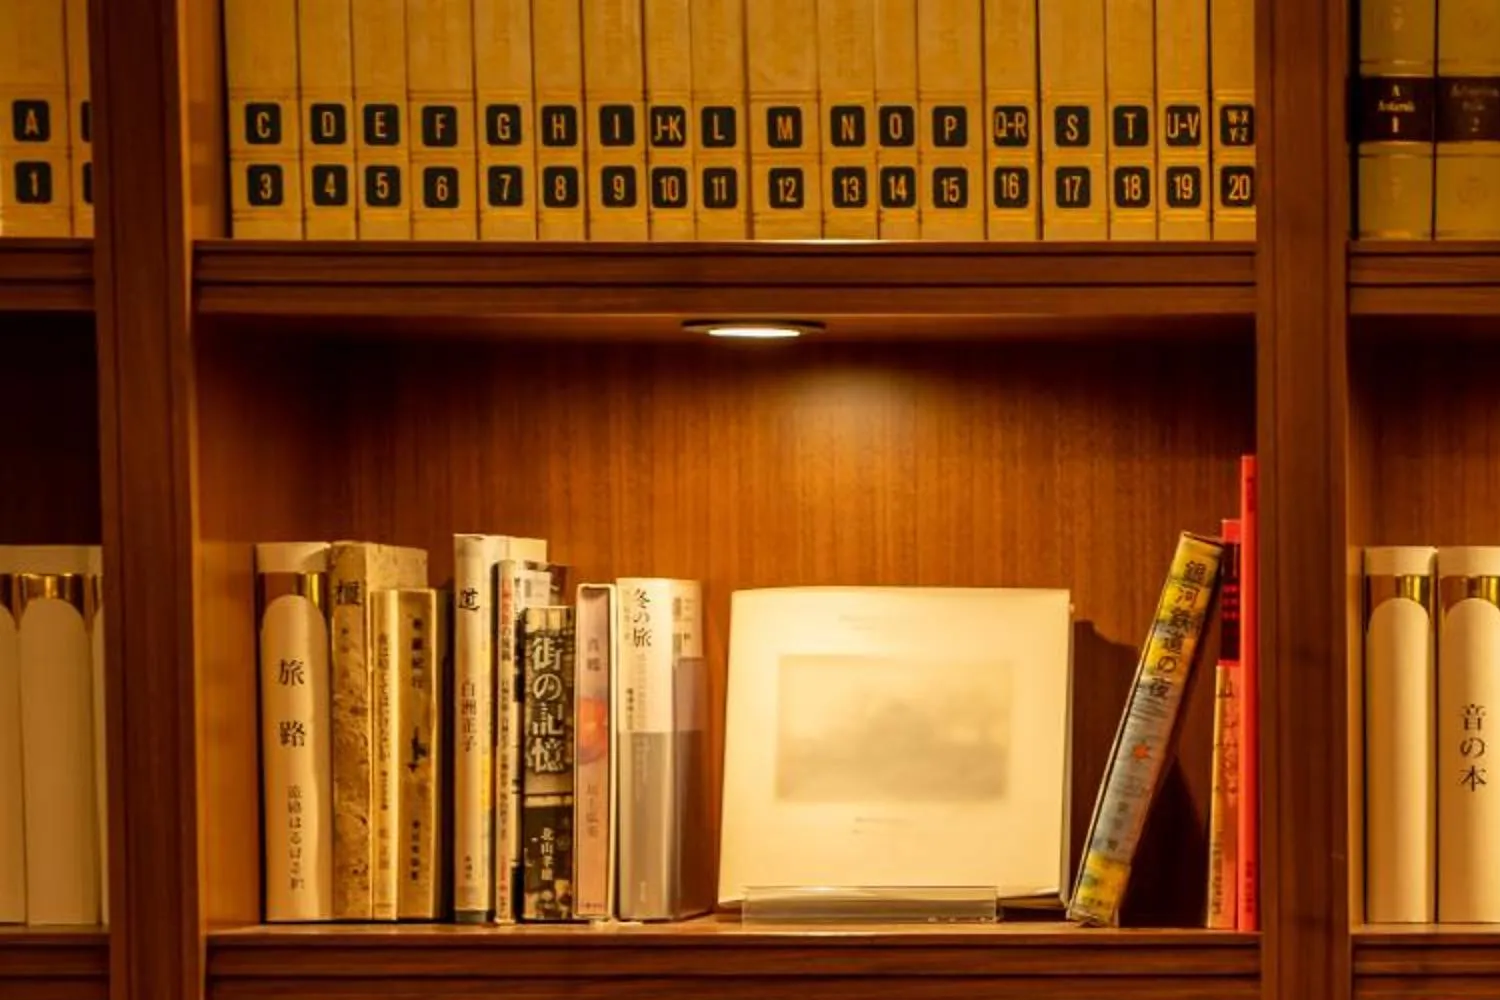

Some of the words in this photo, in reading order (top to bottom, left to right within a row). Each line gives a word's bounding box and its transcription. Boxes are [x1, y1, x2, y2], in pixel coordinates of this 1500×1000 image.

[24, 111, 39, 136] A
[255, 110, 272, 139] C
[321, 110, 335, 139] D
[374, 110, 388, 139] E
[434, 112, 447, 141] F
[496, 111, 511, 141] G
[551, 113, 566, 141] H
[655, 112, 683, 141] J-K
[711, 112, 726, 142] L
[776, 114, 795, 142] M
[841, 113, 856, 142] N
[888, 111, 904, 141] O
[943, 114, 958, 142] P
[995, 111, 1027, 141] Q-R
[1065, 112, 1080, 142] S
[1123, 111, 1138, 141] T
[1166, 111, 1200, 140] U-V
[30, 171, 39, 197] 1
[259, 172, 273, 200] 3
[324, 172, 337, 198] 4
[376, 171, 390, 200] 5
[436, 175, 449, 202] 6
[500, 173, 512, 201] 7
[554, 174, 567, 202] 8
[612, 174, 625, 201] 9
[659, 175, 680, 202] 10
[710, 175, 728, 202] 11
[777, 176, 798, 203] 12
[841, 176, 861, 203] 13
[888, 175, 908, 202] 14
[941, 176, 961, 203] 15
[1001, 173, 1021, 201] 16
[1063, 175, 1083, 203] 17
[1122, 174, 1143, 202] 18
[1174, 173, 1194, 201] 19
[1227, 174, 1251, 202] 20
[634, 587, 653, 648] 冬の旅
[278, 657, 306, 748] 旅路
[531, 635, 566, 773] 街の記憶
[1457, 702, 1488, 793] 音の本
